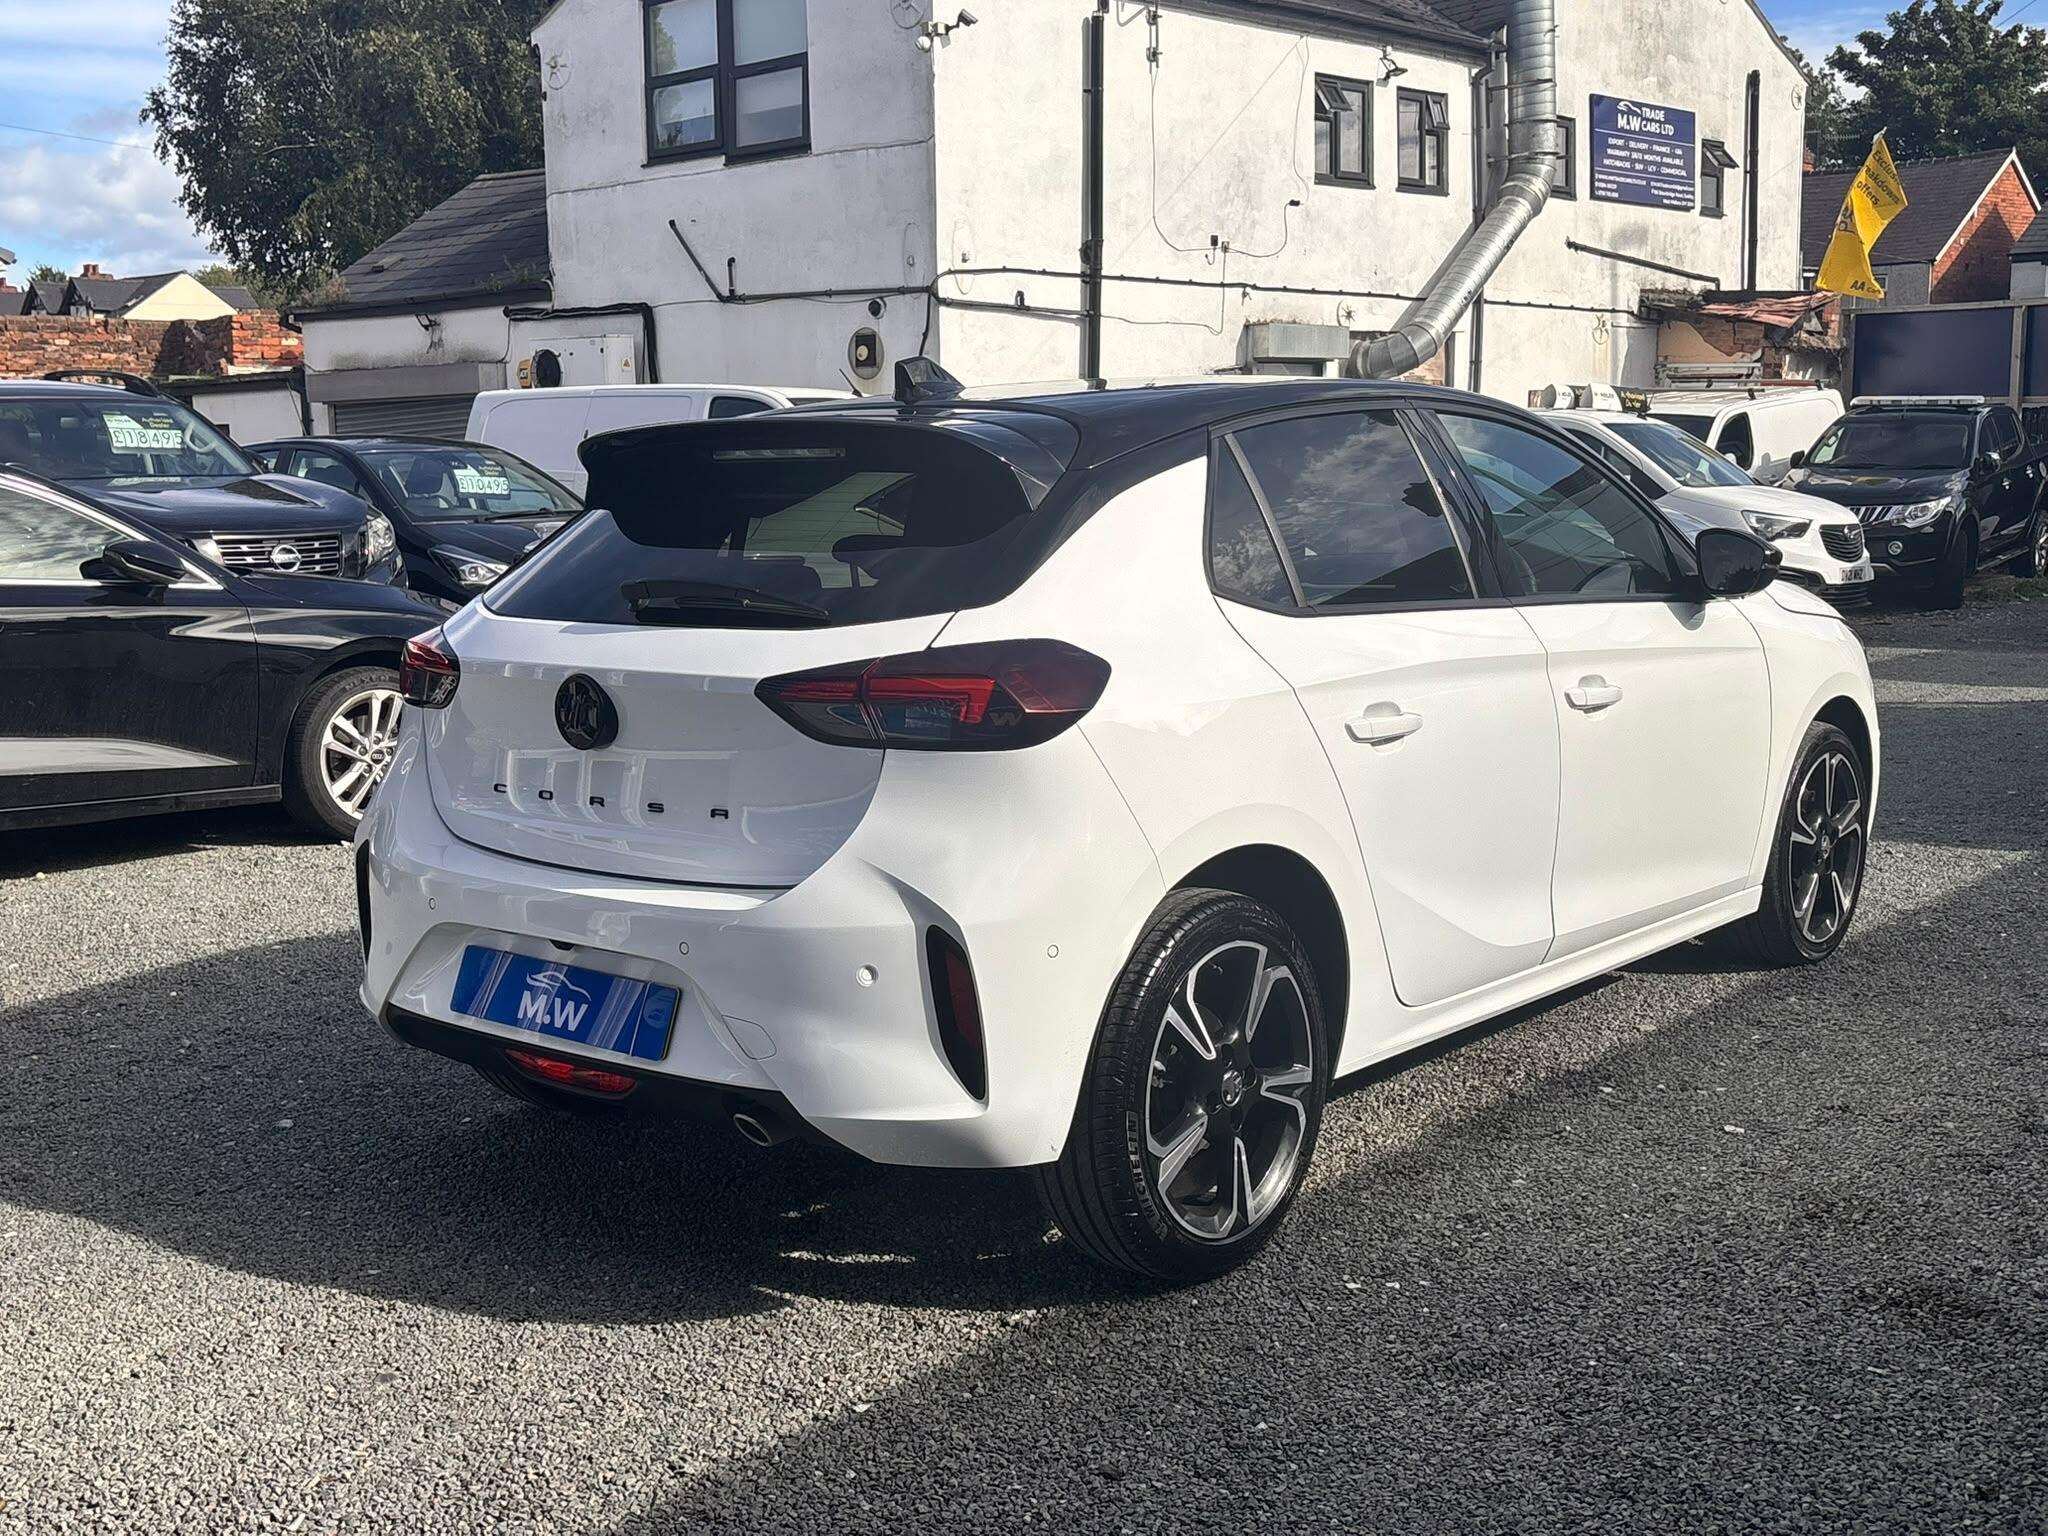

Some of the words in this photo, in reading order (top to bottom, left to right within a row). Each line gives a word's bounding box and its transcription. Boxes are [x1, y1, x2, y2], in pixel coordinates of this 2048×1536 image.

[1617, 113, 1641, 132] M.W
[1642, 107, 1665, 121] TRADE
[1641, 121, 1660, 134] CARS
[1661, 123, 1675, 136] LTD
[1872, 150, 1898, 183] Exclus
[113, 430, 184, 445] £18495
[459, 478, 509, 491] £10495
[493, 783, 729, 820] CORSA
[517, 990, 588, 1032] M.W
